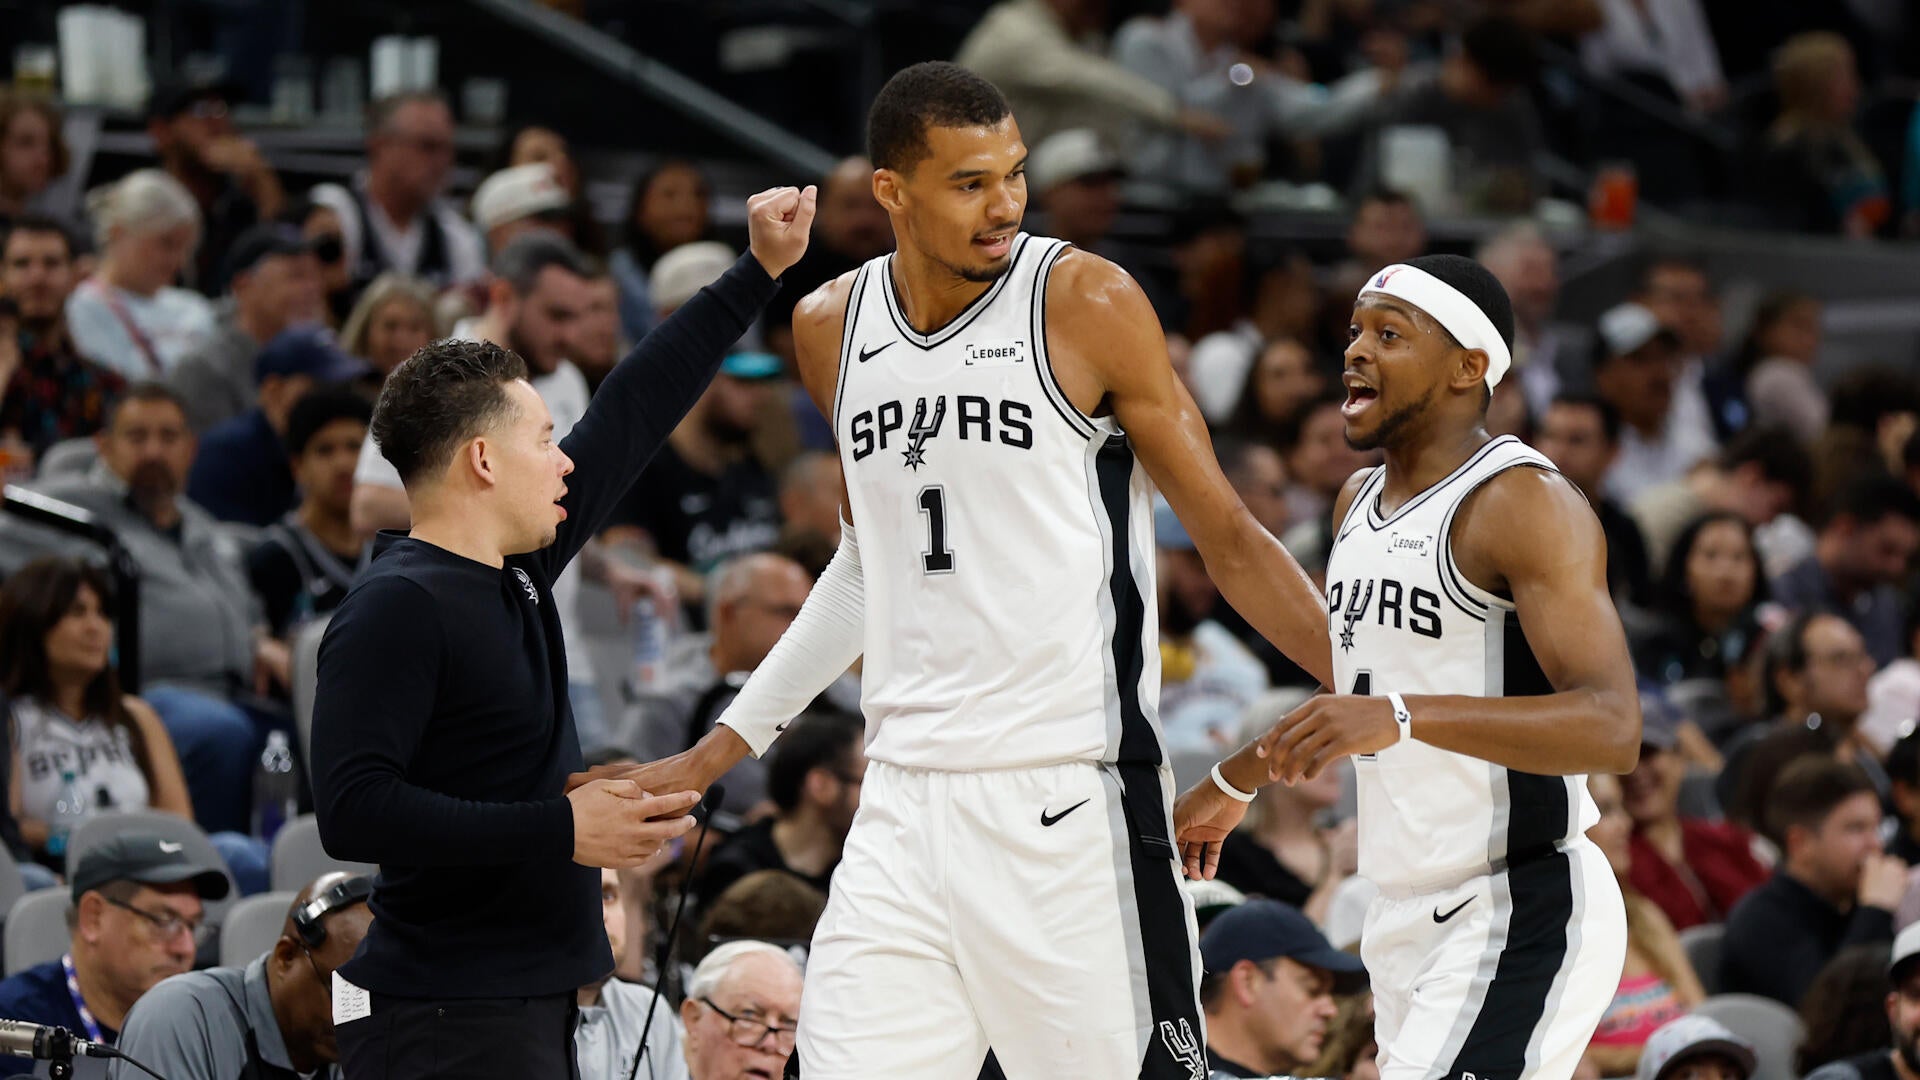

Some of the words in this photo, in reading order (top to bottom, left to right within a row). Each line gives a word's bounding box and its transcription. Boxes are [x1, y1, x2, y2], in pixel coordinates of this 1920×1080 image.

[972, 347, 1016, 359] LEDGER
[851, 395, 1033, 472] SPURS
[917, 484, 955, 576] 1
[1393, 537, 1425, 550] LEDGER
[1326, 578, 1442, 655] PURS
